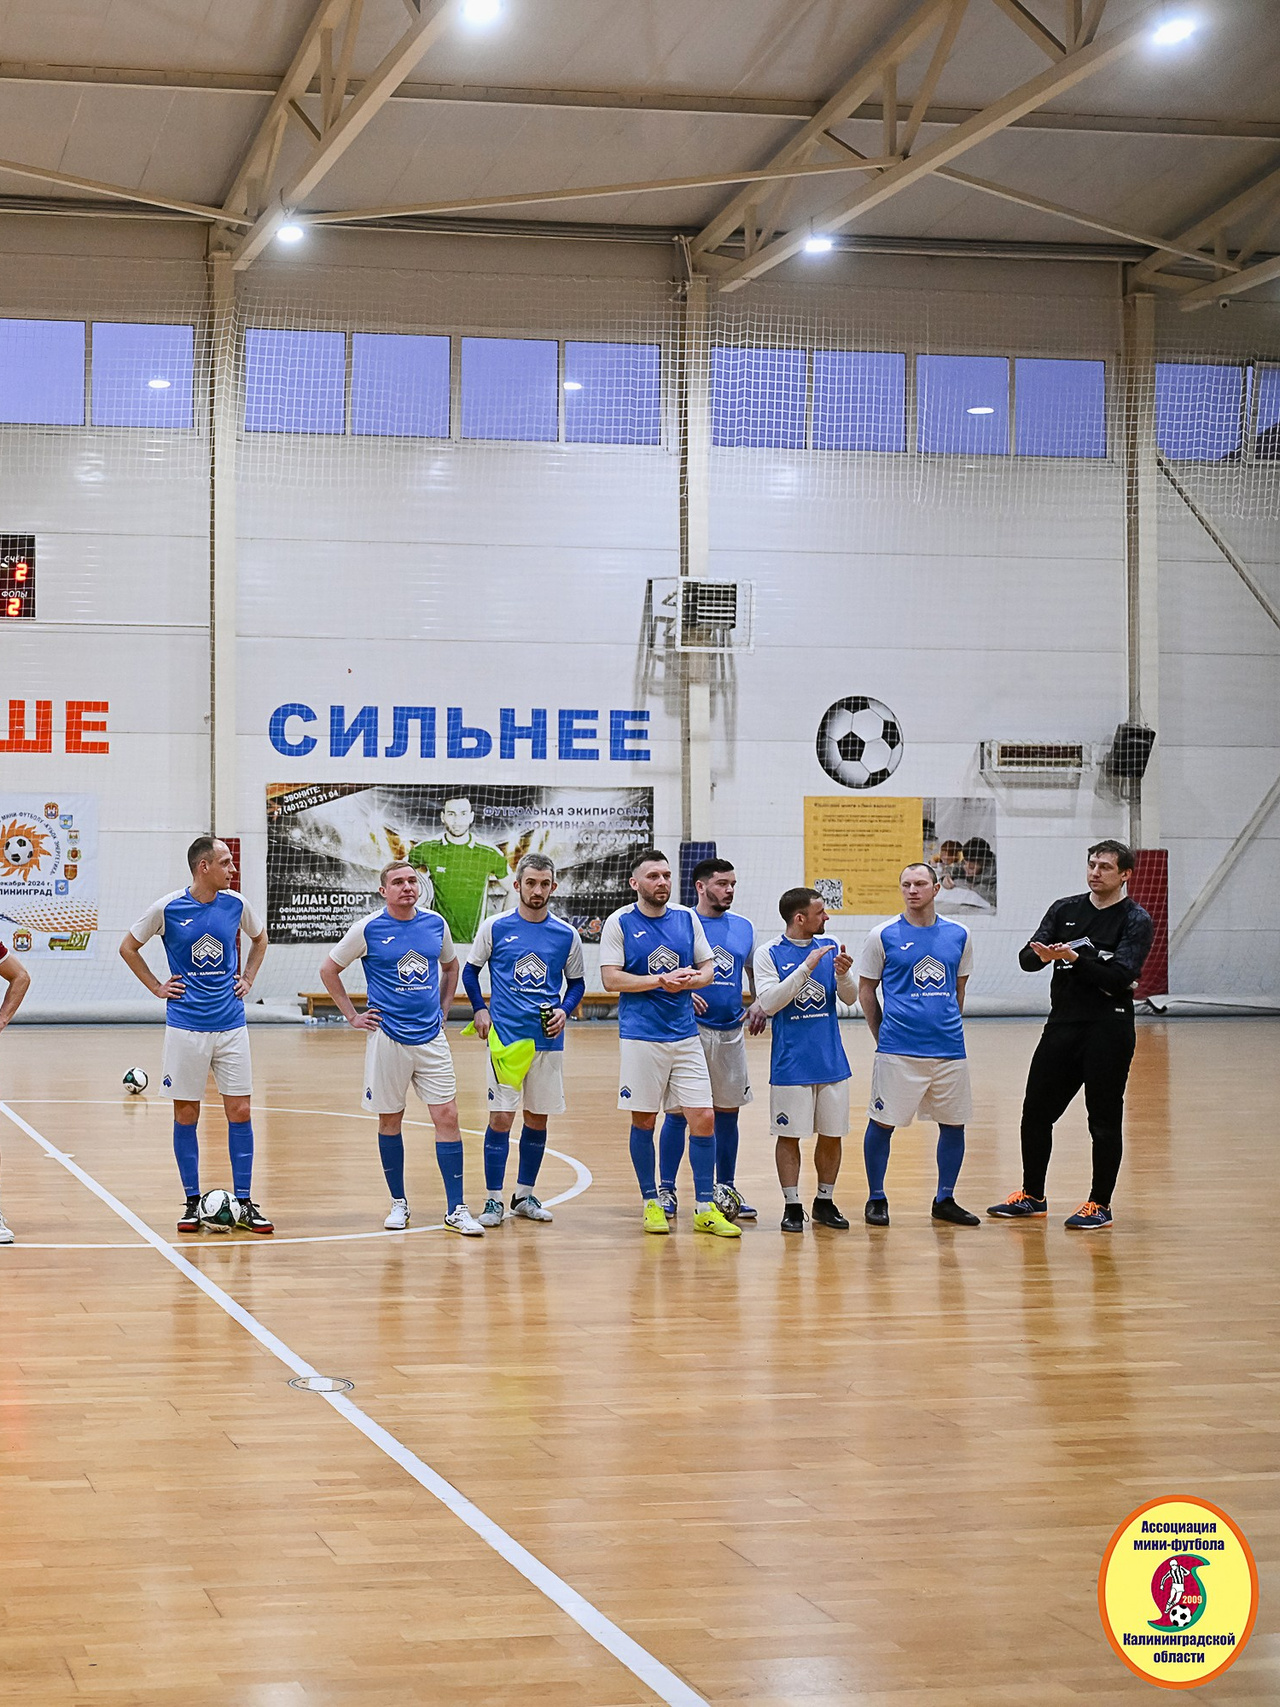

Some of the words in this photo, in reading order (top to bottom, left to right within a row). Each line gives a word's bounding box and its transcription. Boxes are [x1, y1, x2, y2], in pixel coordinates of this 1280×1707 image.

[15, 563, 28, 581] 2
[1, 590, 28, 598] ФОЛЫ
[7, 598, 21, 616] 2
[268, 703, 651, 760] СИЛЬНЕЕ
[283, 786, 321, 803] ЗВОНИТЕ:
[483, 806, 564, 817] ФУТБОЛЬНАЯ
[567, 807, 649, 817] ЭКИПИРОВКА
[292, 894, 327, 905] ИЛАН
[330, 894, 372, 905] СПОРТ
